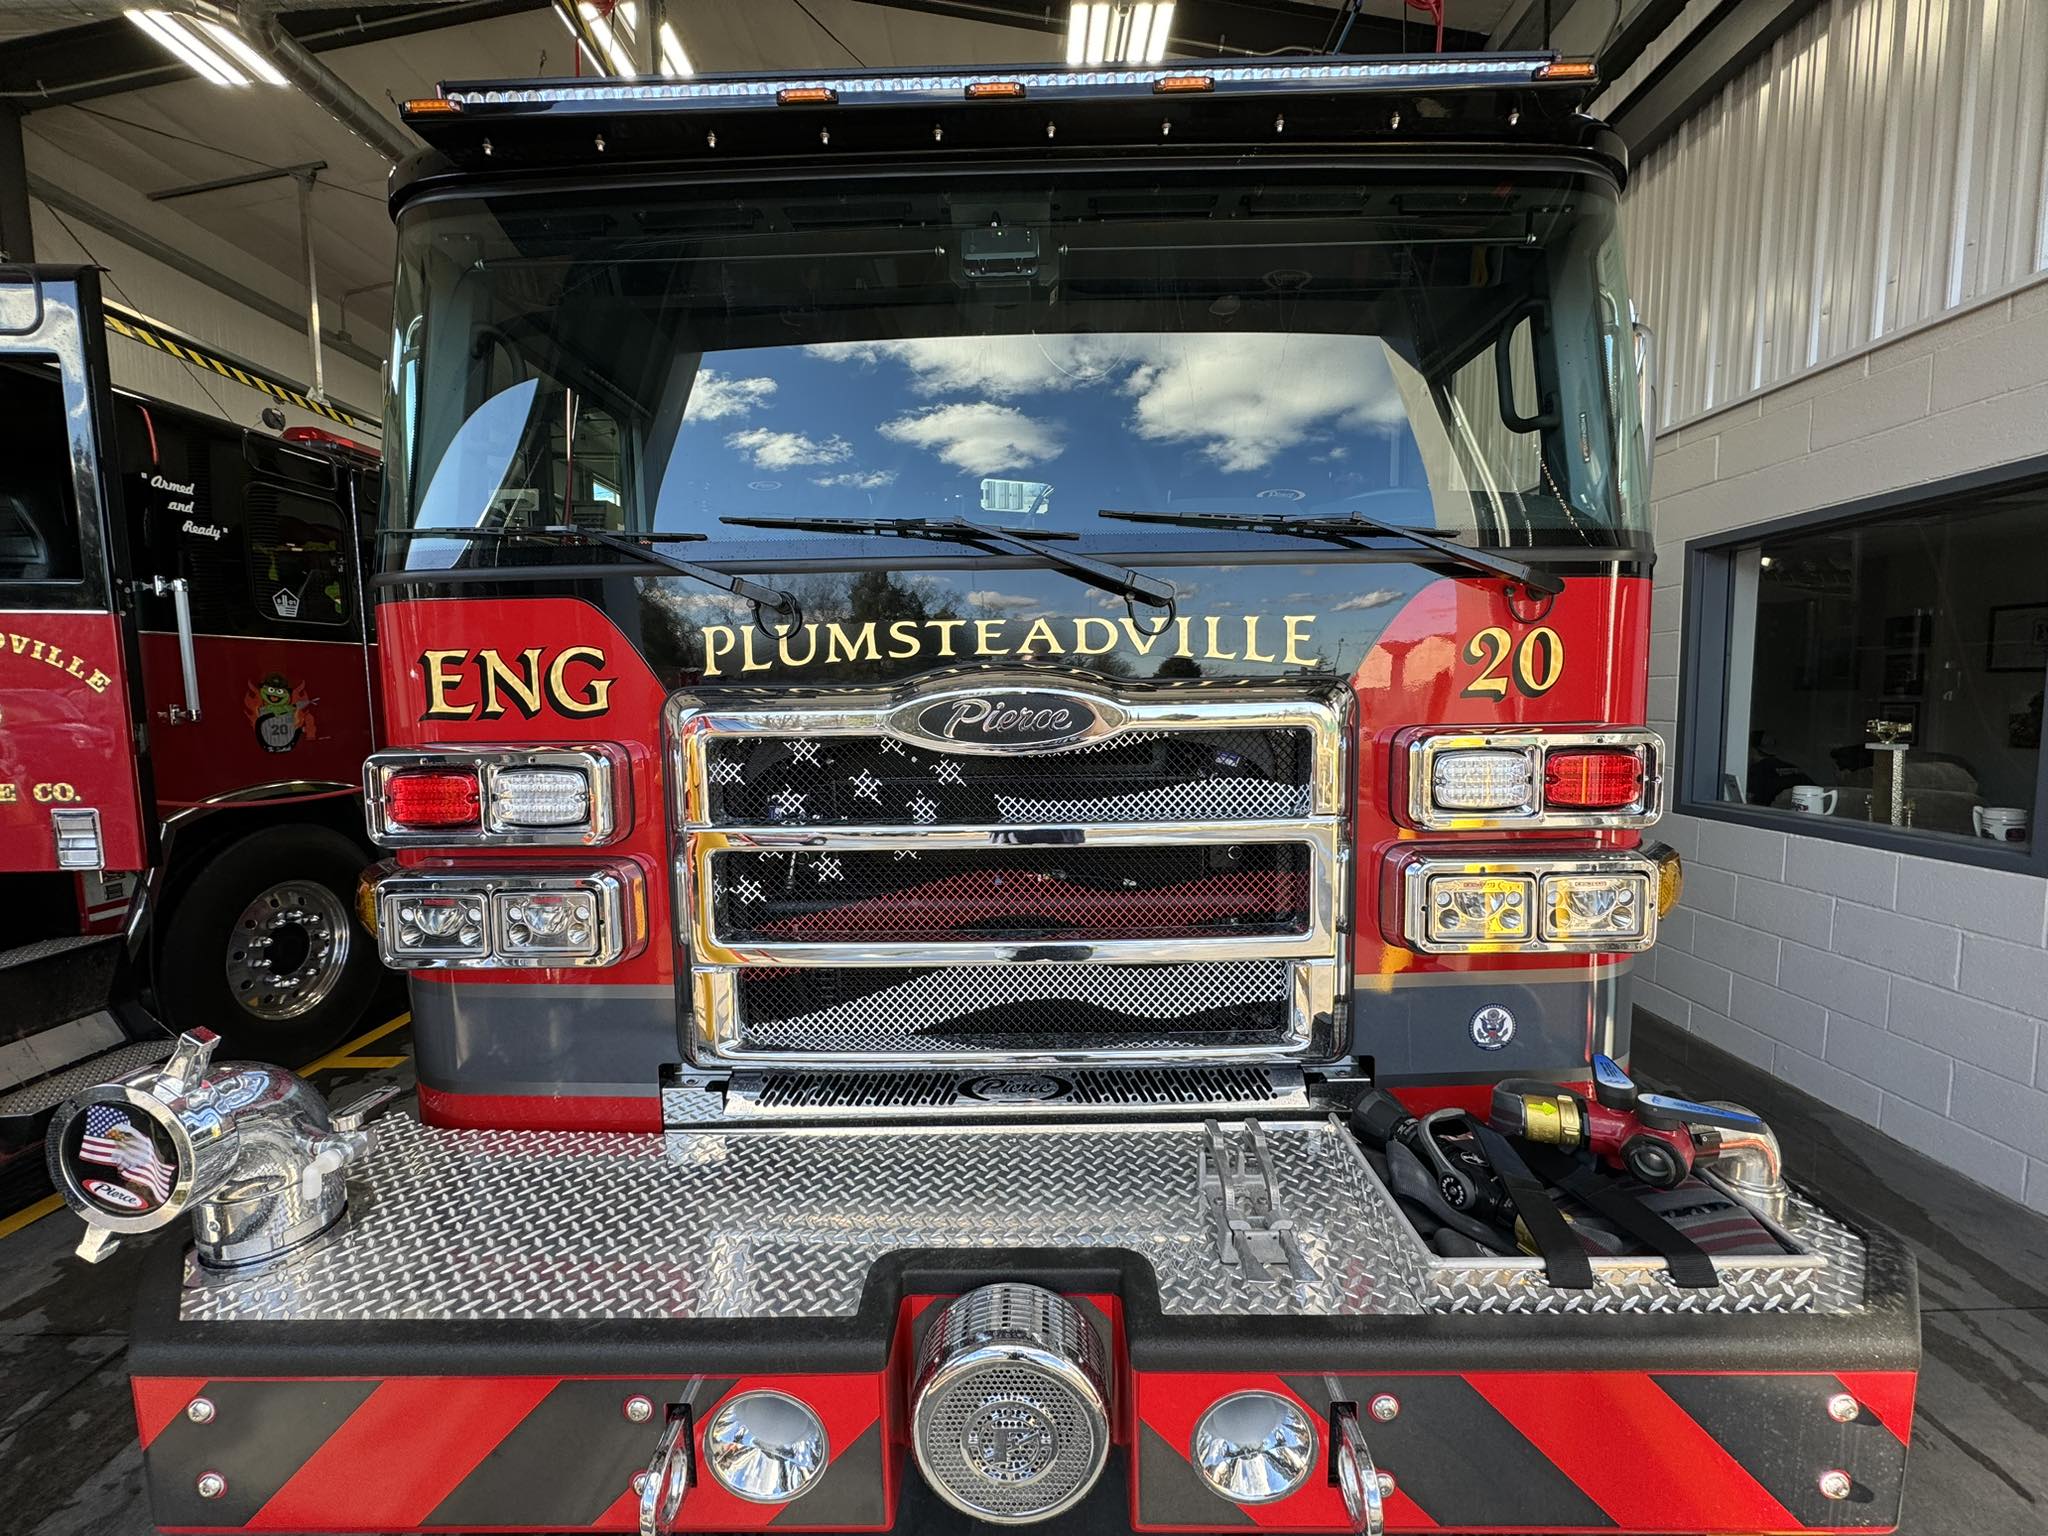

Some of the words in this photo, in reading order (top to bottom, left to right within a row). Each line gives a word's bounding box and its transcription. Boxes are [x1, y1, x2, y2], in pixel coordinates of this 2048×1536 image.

[167, 501, 195, 513] and
[701, 614, 1319, 677] PLUMSTEADVILLE
[0, 632, 112, 693] VILLE
[1461, 625, 1565, 700] 20
[420, 646, 617, 721] ENG
[270, 724, 289, 736] 20
[943, 699, 1073, 739] Pierce
[33, 782, 82, 802] CO.
[978, 1078, 1051, 1095] Pierce
[94, 1183, 138, 1205] Pierce
